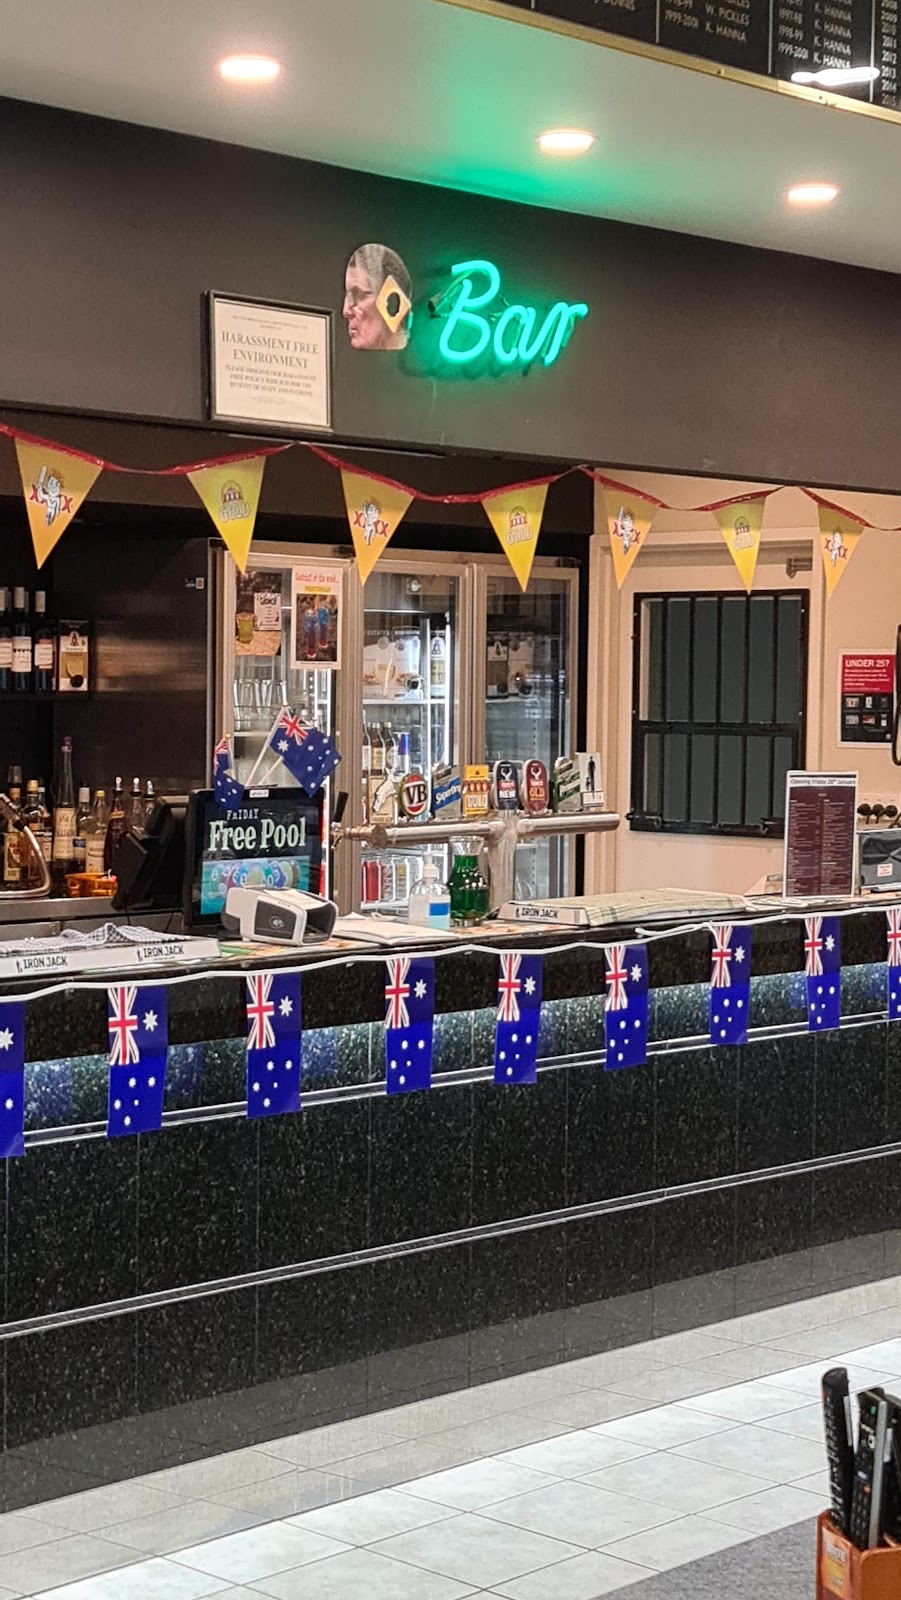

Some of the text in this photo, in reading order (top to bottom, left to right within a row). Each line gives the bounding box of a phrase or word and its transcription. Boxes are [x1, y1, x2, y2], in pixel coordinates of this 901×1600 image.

[718, 6, 750, 26] PICKLES
[824, 4, 852, 22] HANNA
[715, 24, 748, 43] HANNA
[823, 21, 852, 39] HANNA
[823, 37, 852, 56] HANNA
[822, 54, 851, 69] HANNA
[881, 50, 898, 64] 2012
[881, 65, 898, 79] 2013
[439, 259, 588, 366] Bar
[221, 330, 319, 355] HARASSMENT FREE
[233, 348, 309, 369] ENVIRONMENT
[219, 501, 250, 523] GOLD
[506, 526, 533, 545] GOLD
[845, 658, 875, 668] UNDER
[405, 783, 428, 804] VB
[499, 789, 517, 799] NEW
[227, 808, 260, 821] FRIDAY
[208, 816, 307, 851] Free Pool
[521, 907, 559, 919] IRON JACK
[143, 944, 185, 959] IRON JACK
[23, 955, 69, 969] IRON JACK
